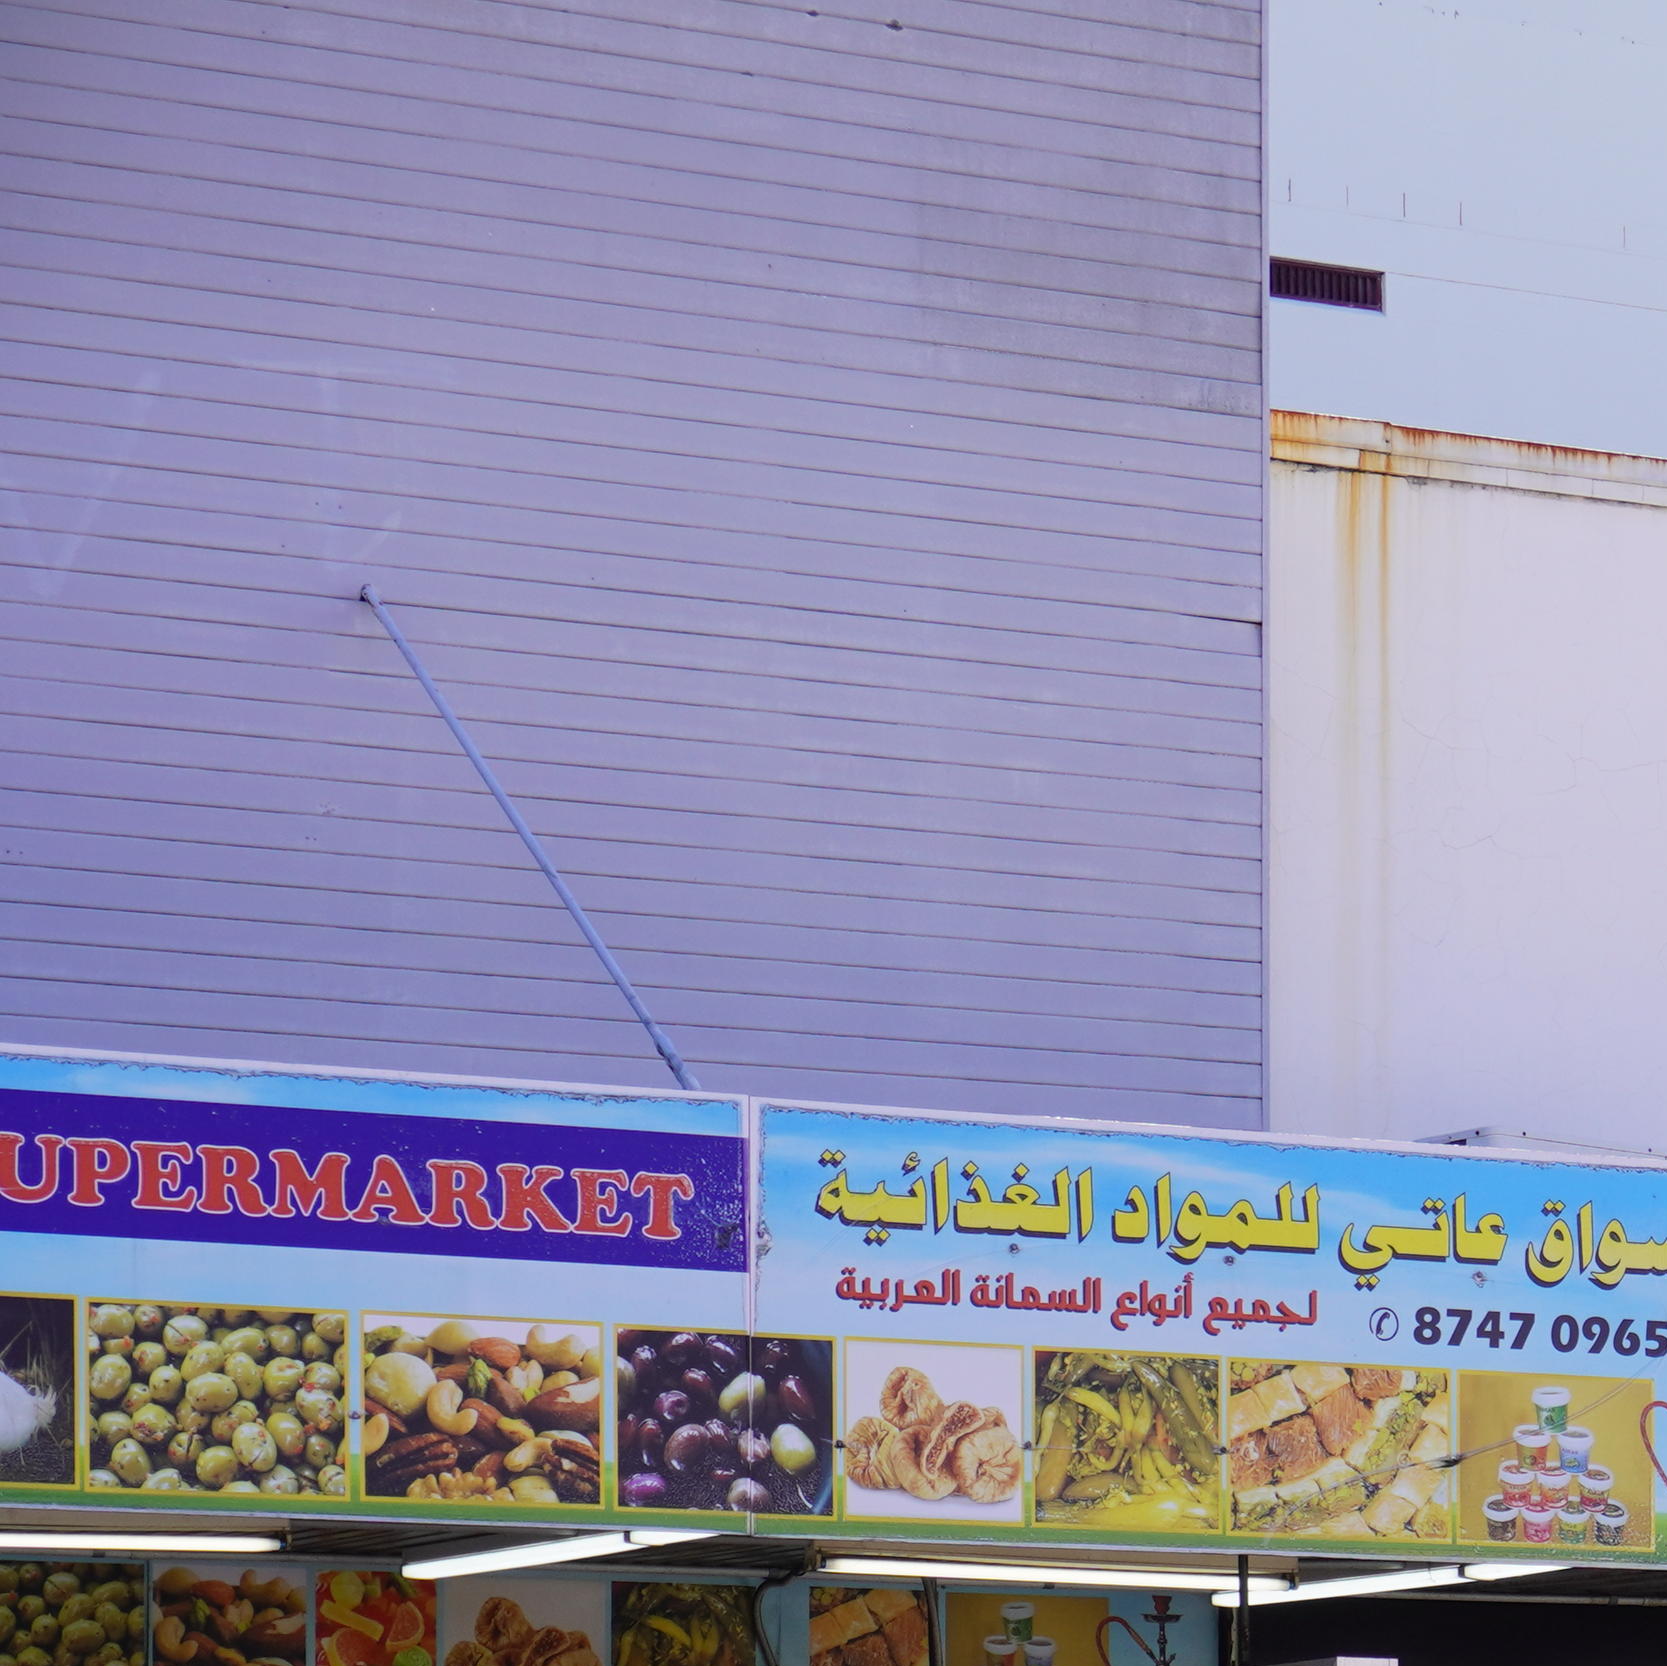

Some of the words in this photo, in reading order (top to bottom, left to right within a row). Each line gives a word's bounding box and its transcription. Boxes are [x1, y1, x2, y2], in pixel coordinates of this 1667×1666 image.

[0, 1131, 695, 1241] UPERMARKET
[814, 1150, 1094, 1247] الغذائية
[1112, 1173, 1320, 1265] للمواد
[1339, 1191, 1509, 1289] عاتي
[835, 1267, 961, 1309] العربية
[1111, 1270, 1194, 1332] أنواع
[1203, 1288, 1319, 1334] لجميع
[1412, 1306, 1535, 1352] 8747
